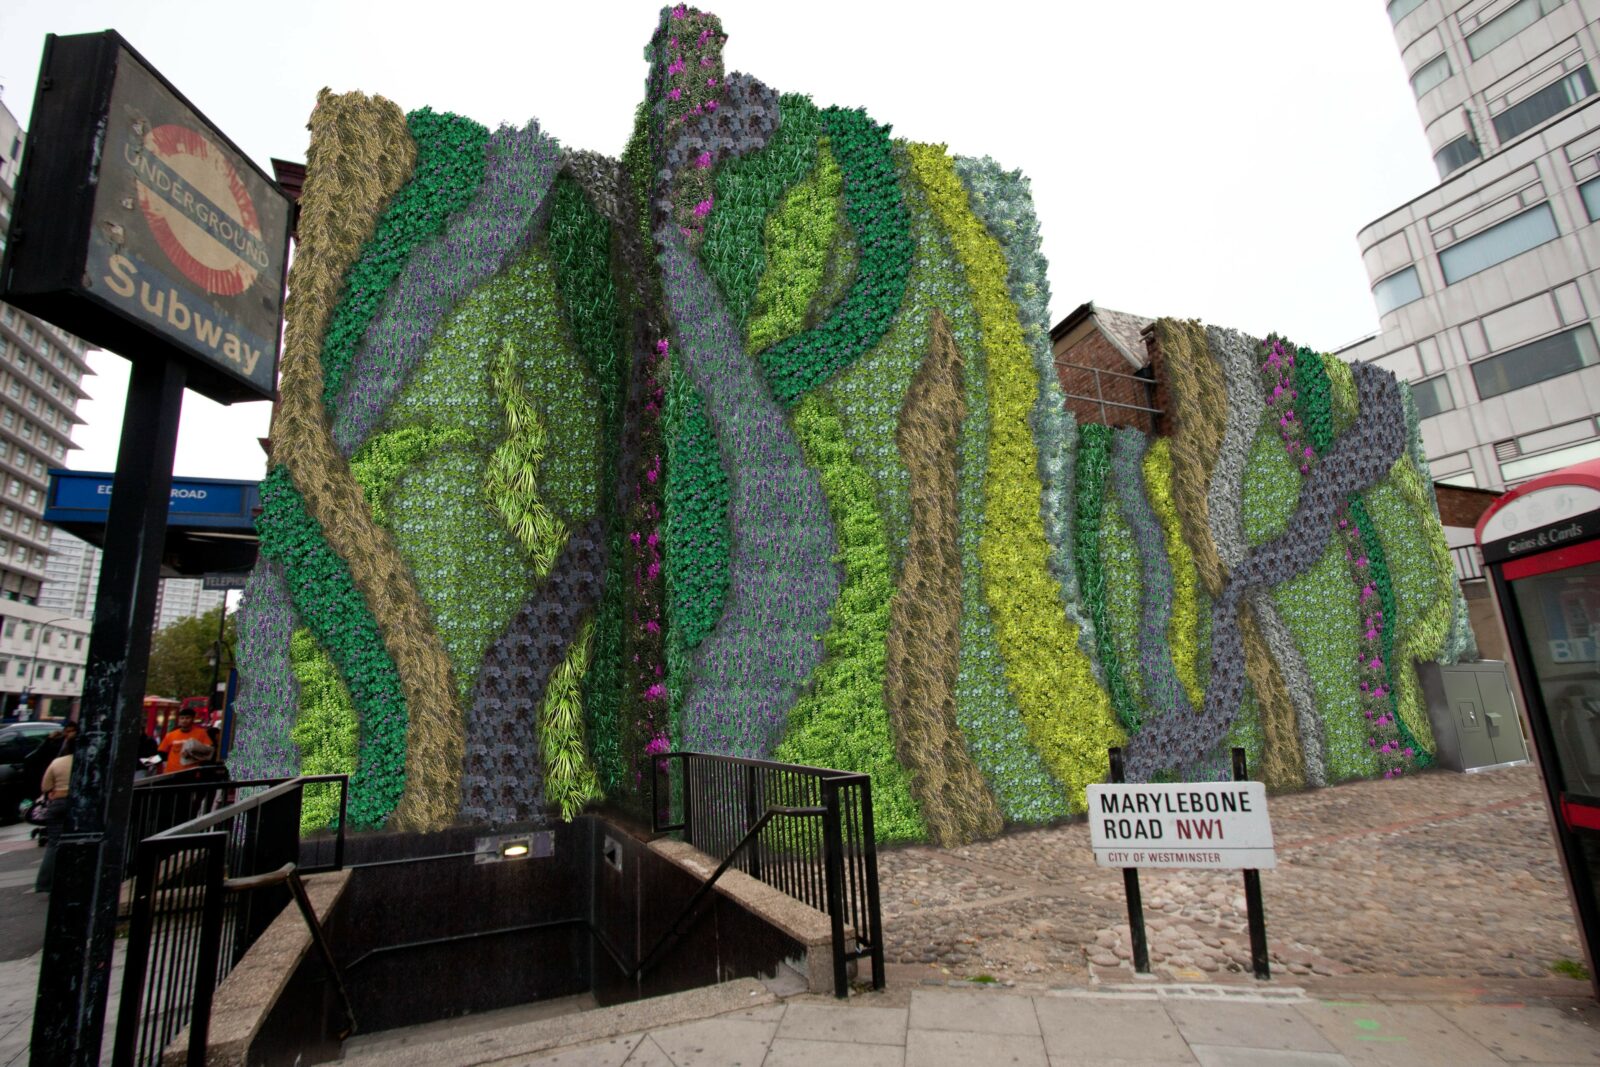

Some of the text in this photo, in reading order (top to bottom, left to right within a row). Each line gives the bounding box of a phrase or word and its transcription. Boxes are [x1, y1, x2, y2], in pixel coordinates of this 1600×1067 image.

[124, 143, 270, 268] UNDERGROUND
[104, 254, 260, 376] Subway
[170, 488, 207, 499] ROAD
[1537, 532, 1548, 546] &
[1548, 523, 1583, 543] Cards
[206, 576, 247, 587] TELEPHO
[1100, 791, 1252, 814] MARYLEBONE
[1104, 818, 1224, 840] ROAD NW1
[1108, 852, 1221, 863] CITY OF WESTMINSTER
